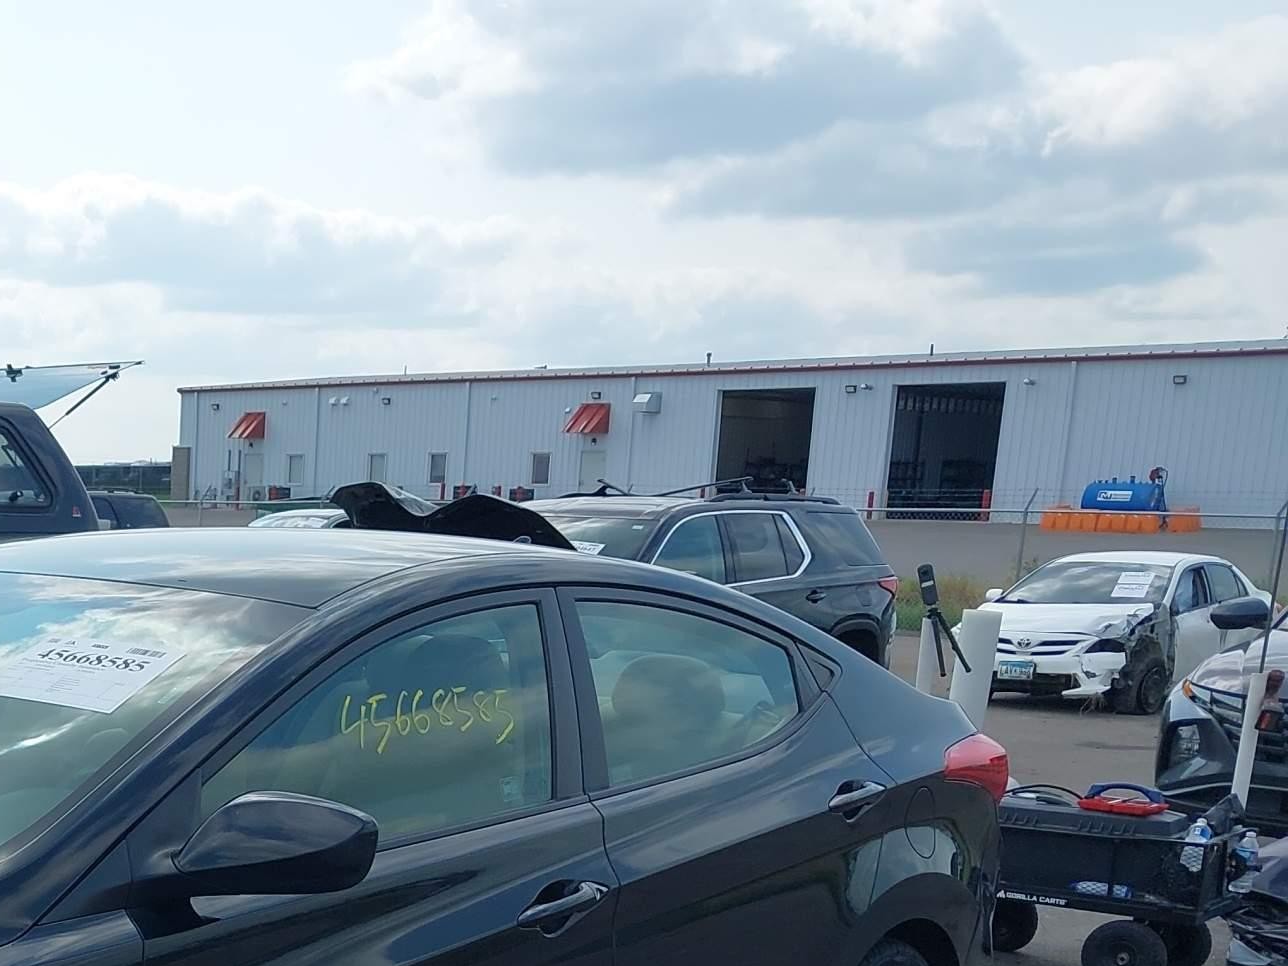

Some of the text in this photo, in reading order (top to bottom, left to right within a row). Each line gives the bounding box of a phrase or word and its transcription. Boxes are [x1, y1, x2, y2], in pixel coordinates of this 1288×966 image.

[38, 648, 152, 673] 45668585
[341, 686, 514, 754] 45668585
[1006, 892, 1037, 902] GORILLA
